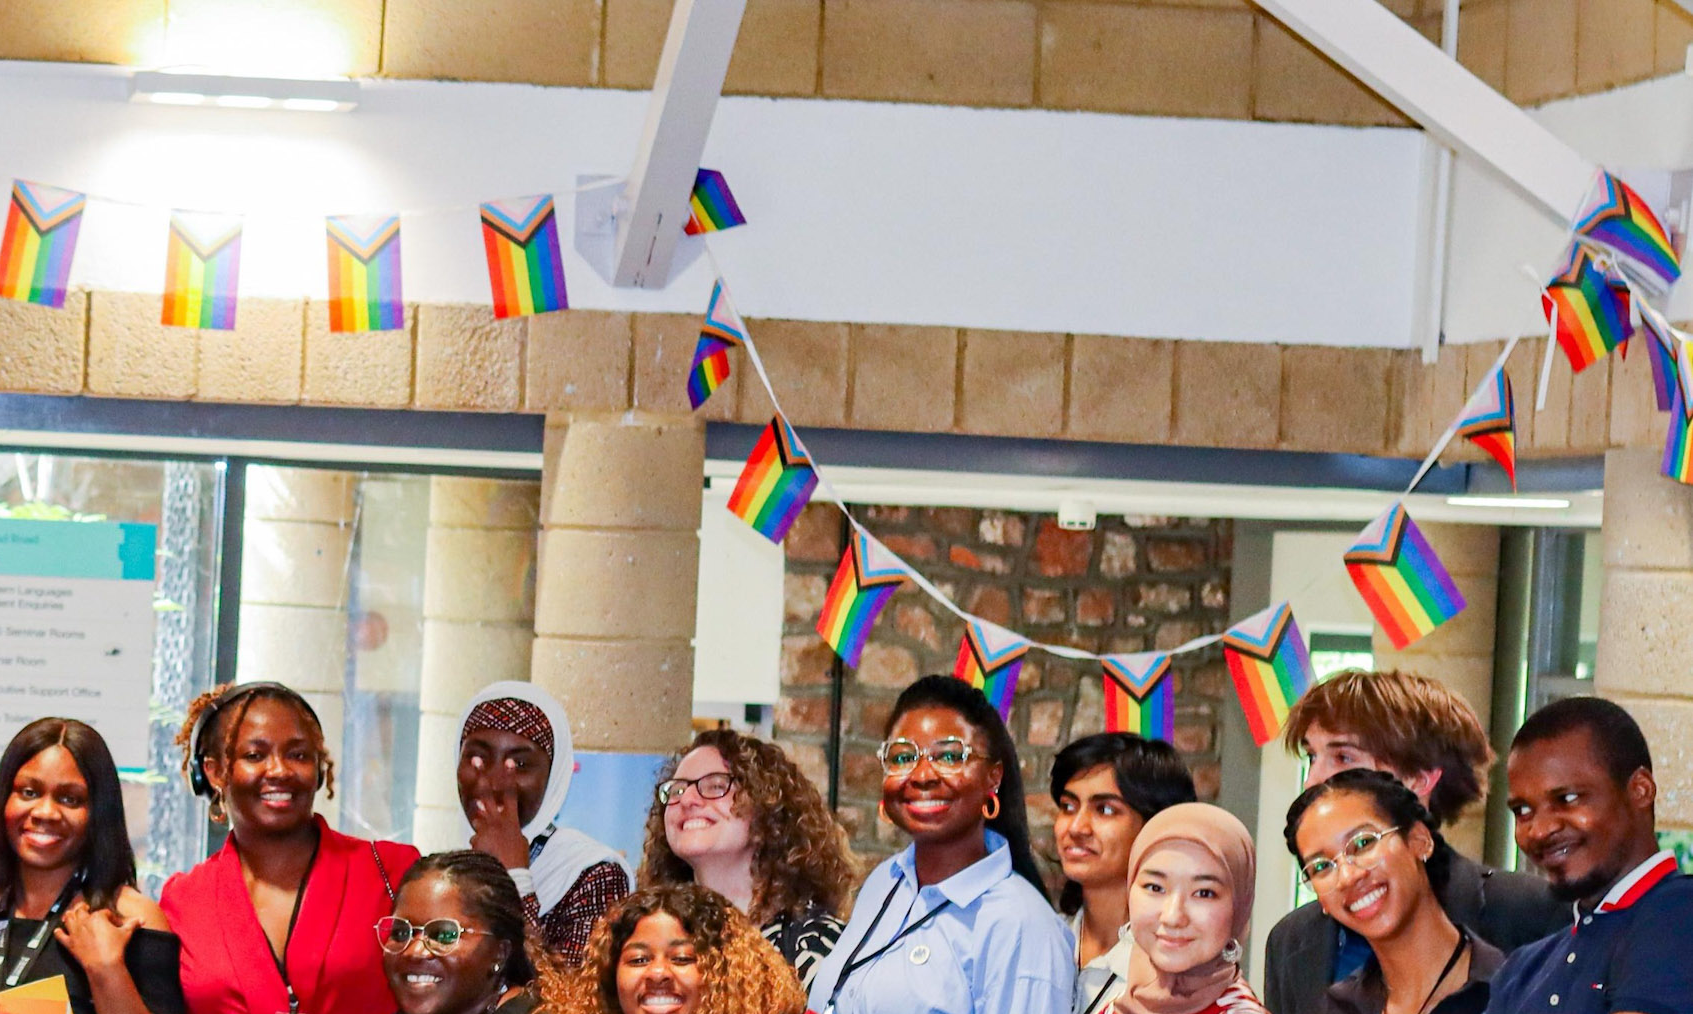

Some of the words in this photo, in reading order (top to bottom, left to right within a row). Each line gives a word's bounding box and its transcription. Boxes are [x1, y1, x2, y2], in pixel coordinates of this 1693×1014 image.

[11, 532, 40, 545] Road
[17, 585, 73, 598] Languages
[18, 599, 63, 611] Enquiries
[6, 626, 46, 638] Seminar
[49, 628, 85, 640] Rooms
[16, 655, 46, 666] Room
[29, 685, 68, 698] Support
[71, 686, 101, 698] Office
